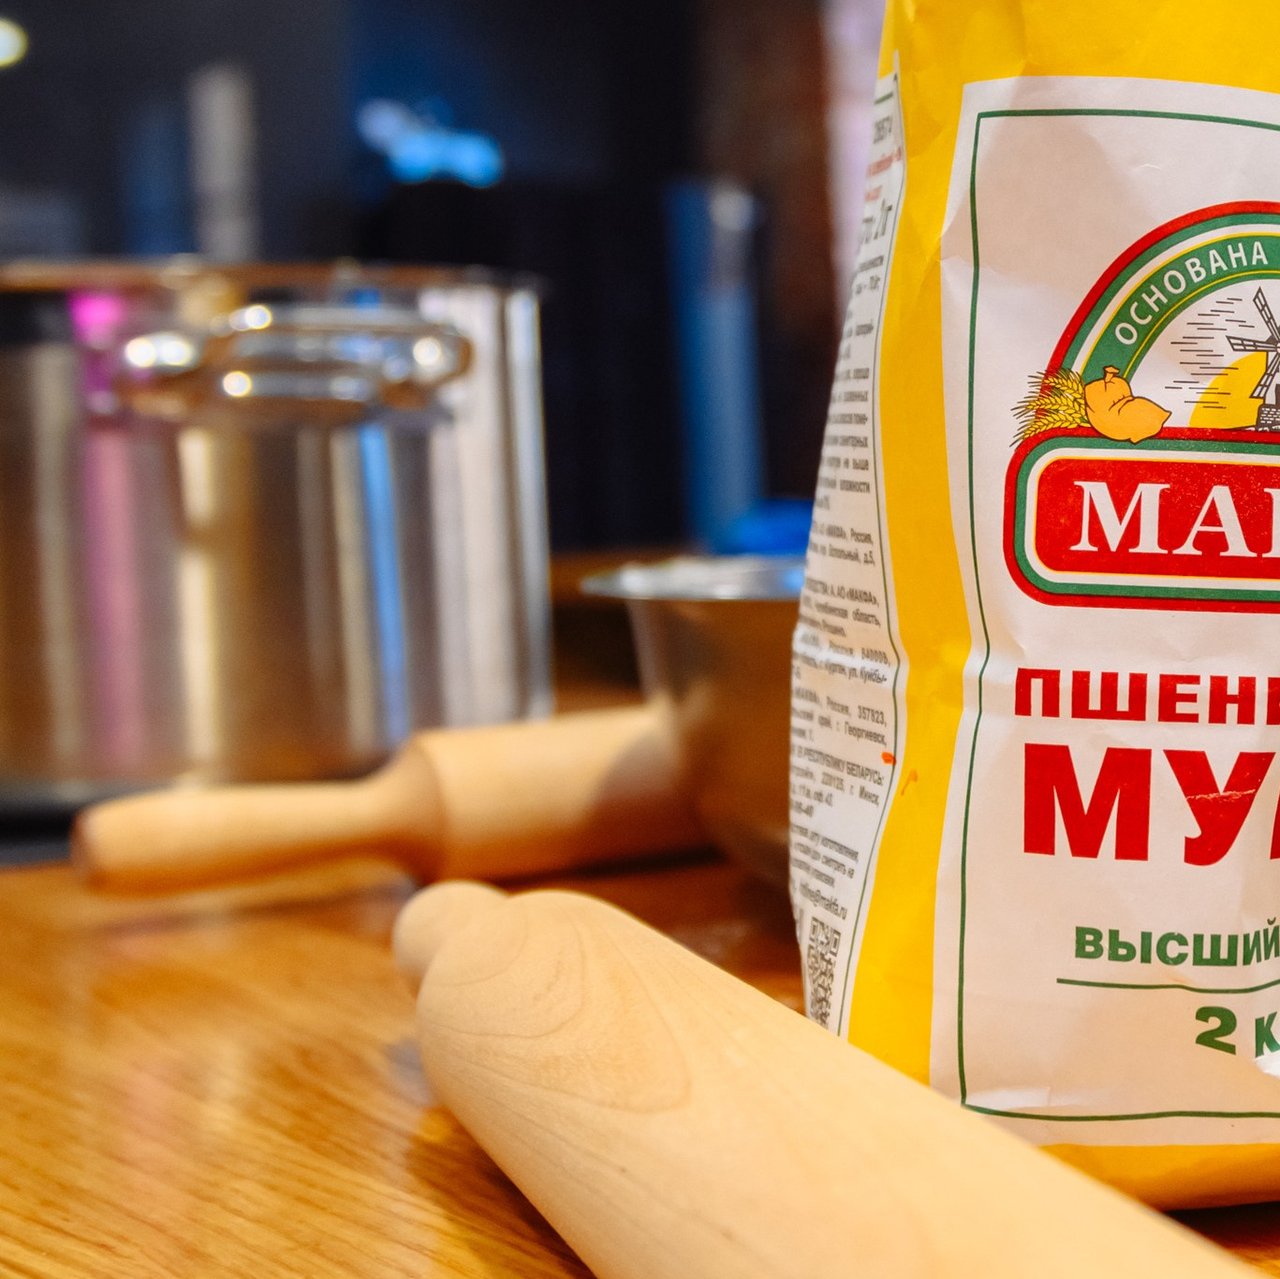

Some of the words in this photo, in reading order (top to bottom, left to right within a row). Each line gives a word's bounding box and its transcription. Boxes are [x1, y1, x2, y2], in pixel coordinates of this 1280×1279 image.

[1114, 240, 1270, 347] ОСНОВАНА
[1074, 917, 1280, 968] ВЫСШИЙ
[1194, 1005, 1238, 1056] 2
